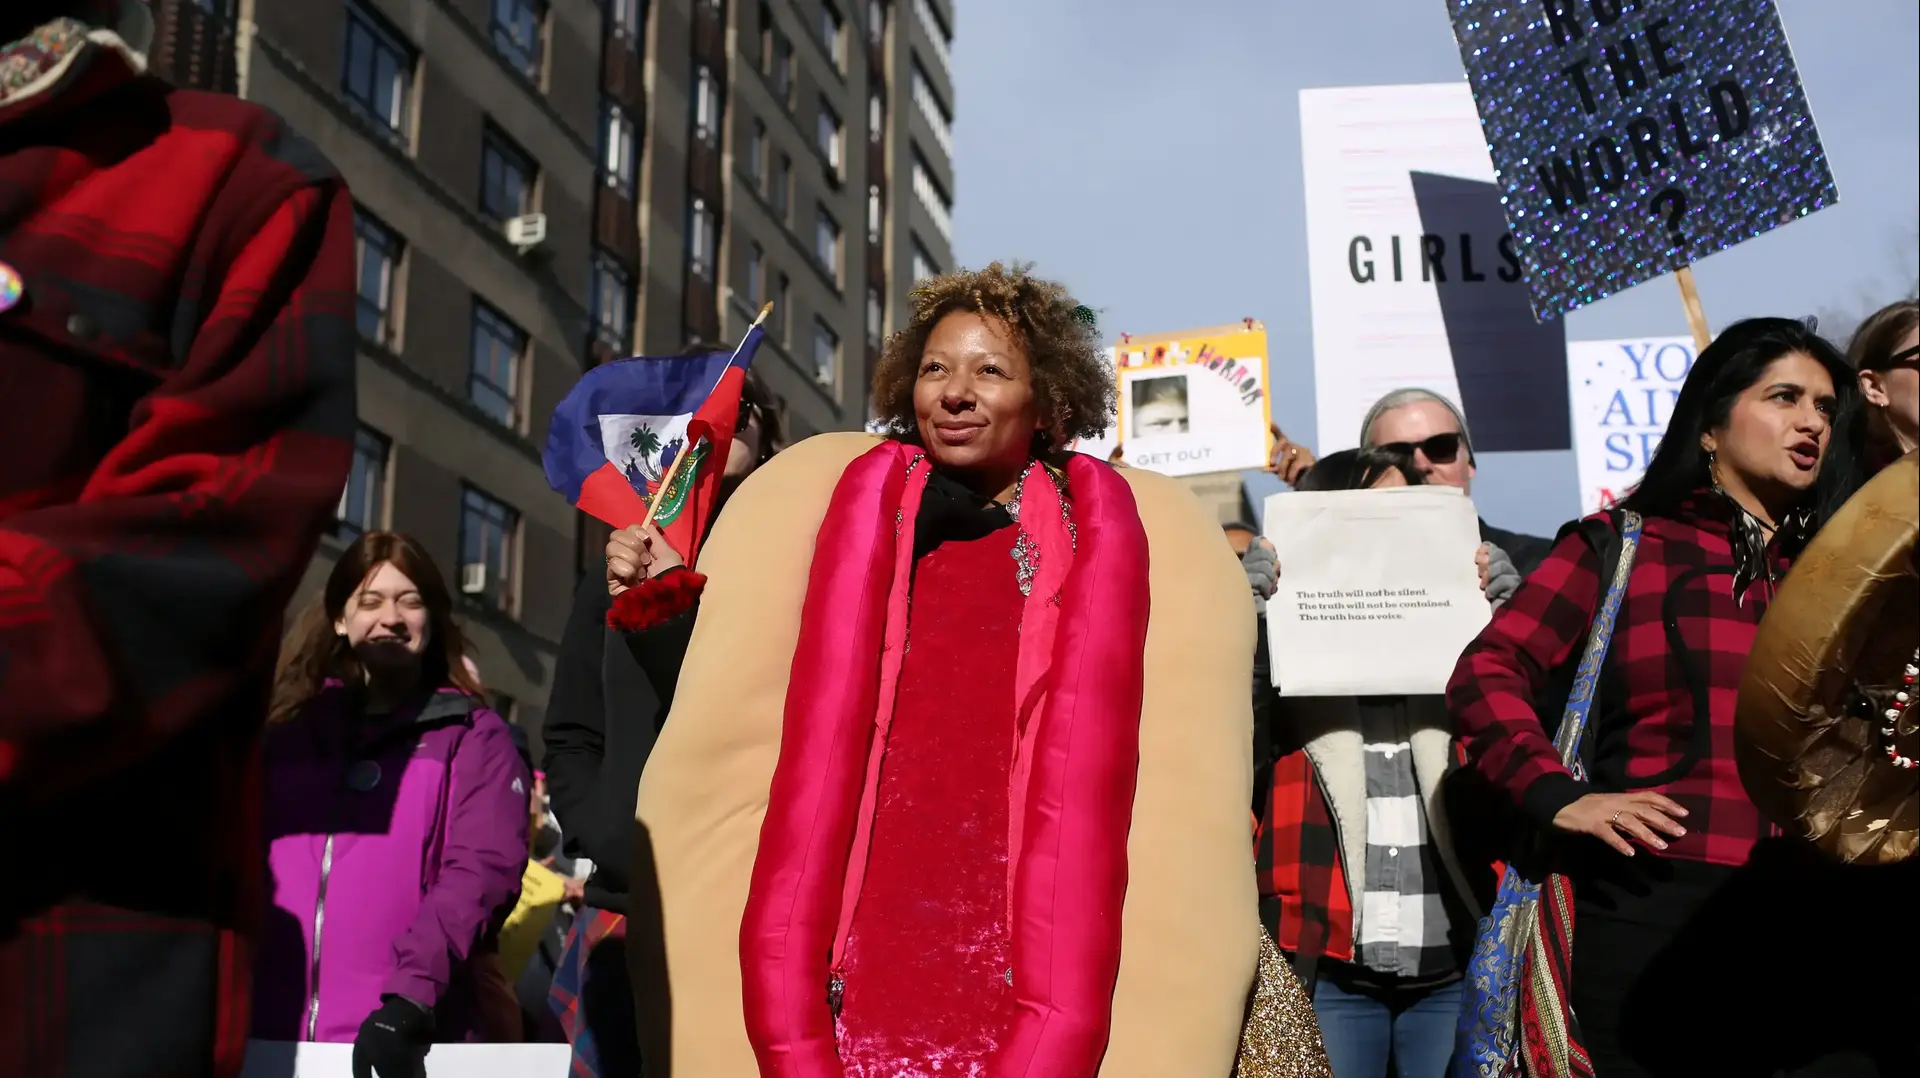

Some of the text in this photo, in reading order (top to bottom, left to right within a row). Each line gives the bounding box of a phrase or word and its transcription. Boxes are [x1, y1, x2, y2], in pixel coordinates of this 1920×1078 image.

[1543, 0, 1643, 47] RU
[1562, 18, 1686, 114] THE
[1537, 80, 1750, 214] WORLD
[1650, 188, 1686, 246] ?
[1348, 234, 1522, 284] GIRLS
[1620, 343, 1697, 382] YO
[1599, 389, 1680, 426] AI
[1136, 447, 1212, 466] GET OUT
[1296, 588, 1428, 599] The truth will not be silent.
[1319, 602, 1345, 610] truth
[1347, 601, 1365, 609] will
[1366, 601, 1383, 609] not
[1385, 600, 1397, 608] be
[1399, 600, 1453, 608] contained.
[1299, 613, 1319, 621] The
[1320, 613, 1346, 621] truth
[1376, 612, 1405, 620] voice.
